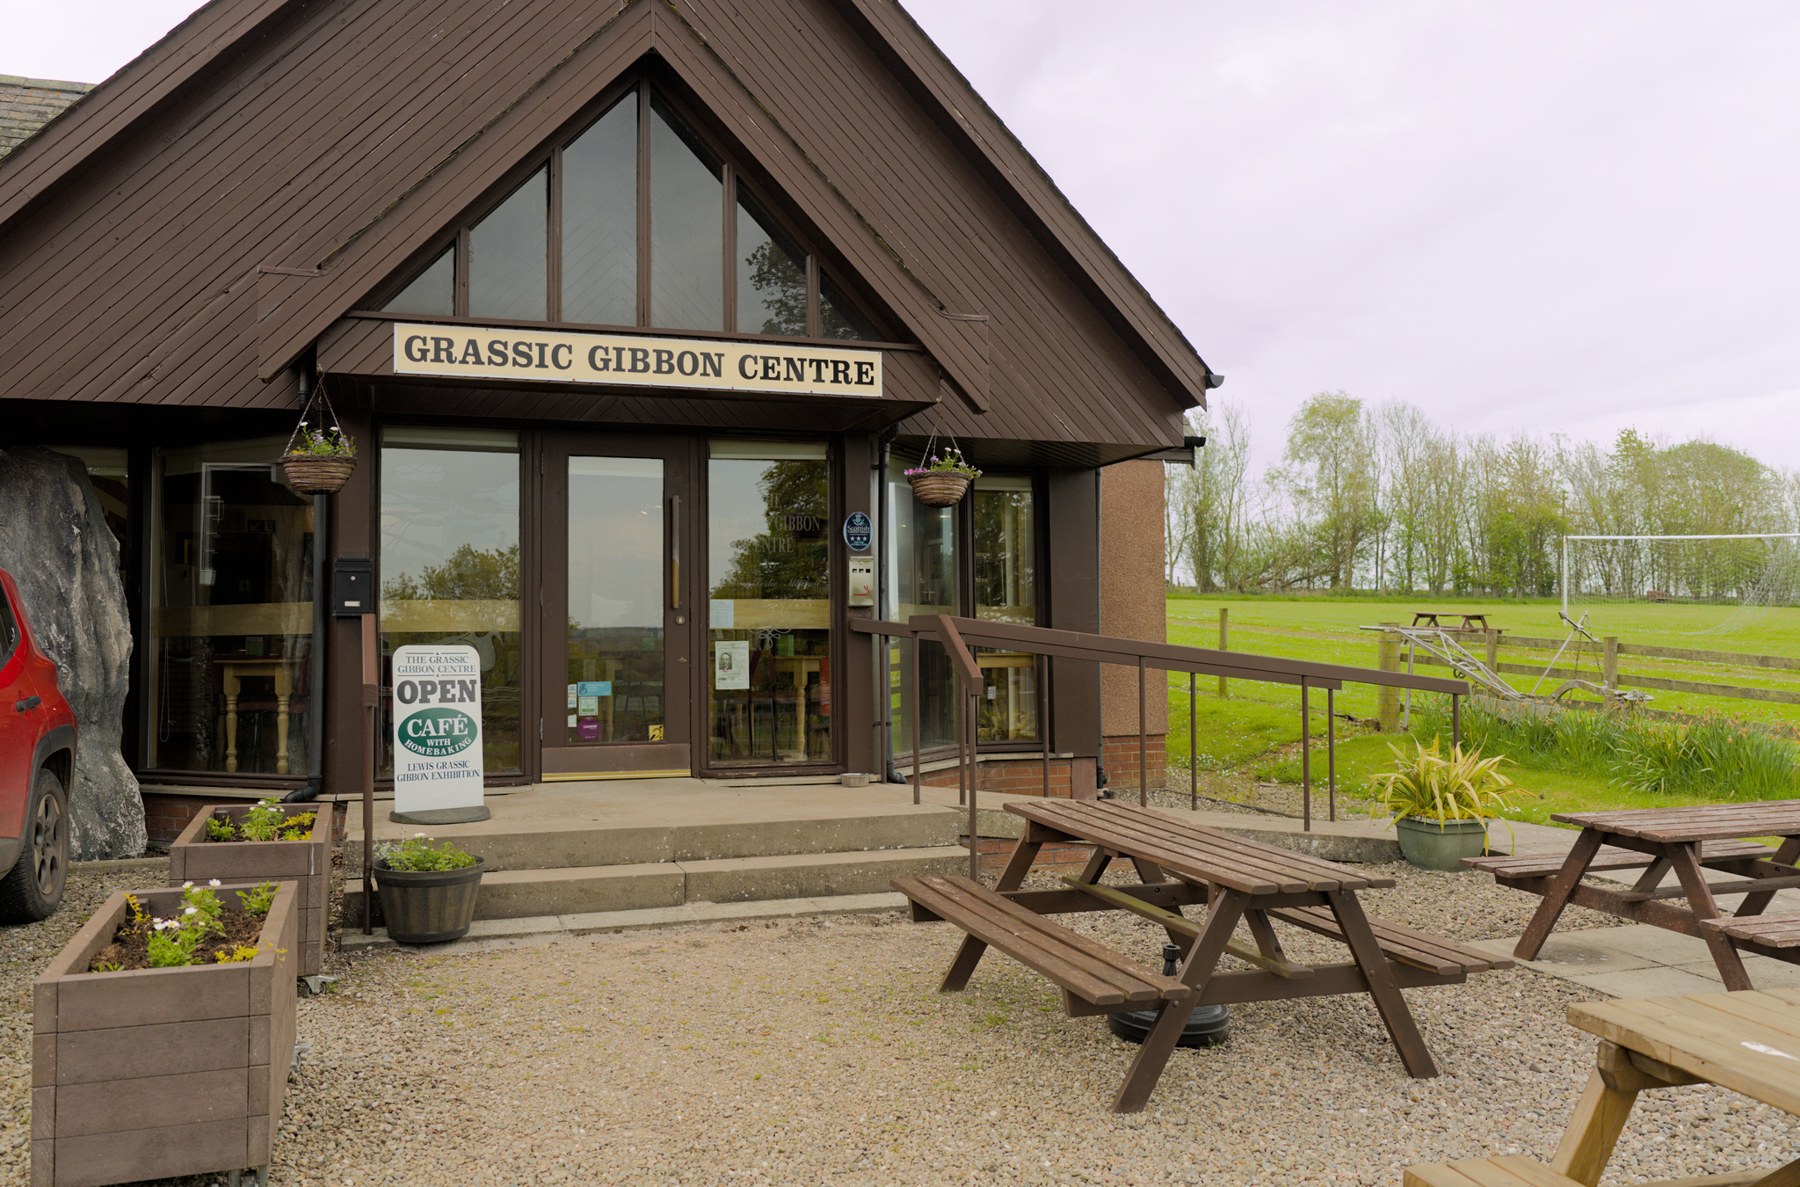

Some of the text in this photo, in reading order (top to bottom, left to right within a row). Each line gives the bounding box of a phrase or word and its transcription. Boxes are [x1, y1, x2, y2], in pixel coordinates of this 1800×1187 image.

[404, 335, 875, 386] GRASSIC GIBBON CENTRE
[774, 515, 820, 532] GIBBON
[406, 655, 469, 664] THE GRASSIC
[397, 665, 477, 674] GIBBON CENTRE
[396, 679, 477, 705] OPEN
[406, 714, 468, 737] CAFÉ
[404, 738, 472, 756] HOMEBAKING
[426, 738, 451, 747] WITH
[407, 760, 470, 772] LEWIS GRASSIC
[396, 769, 480, 783] GIBBON EXHIBITION
